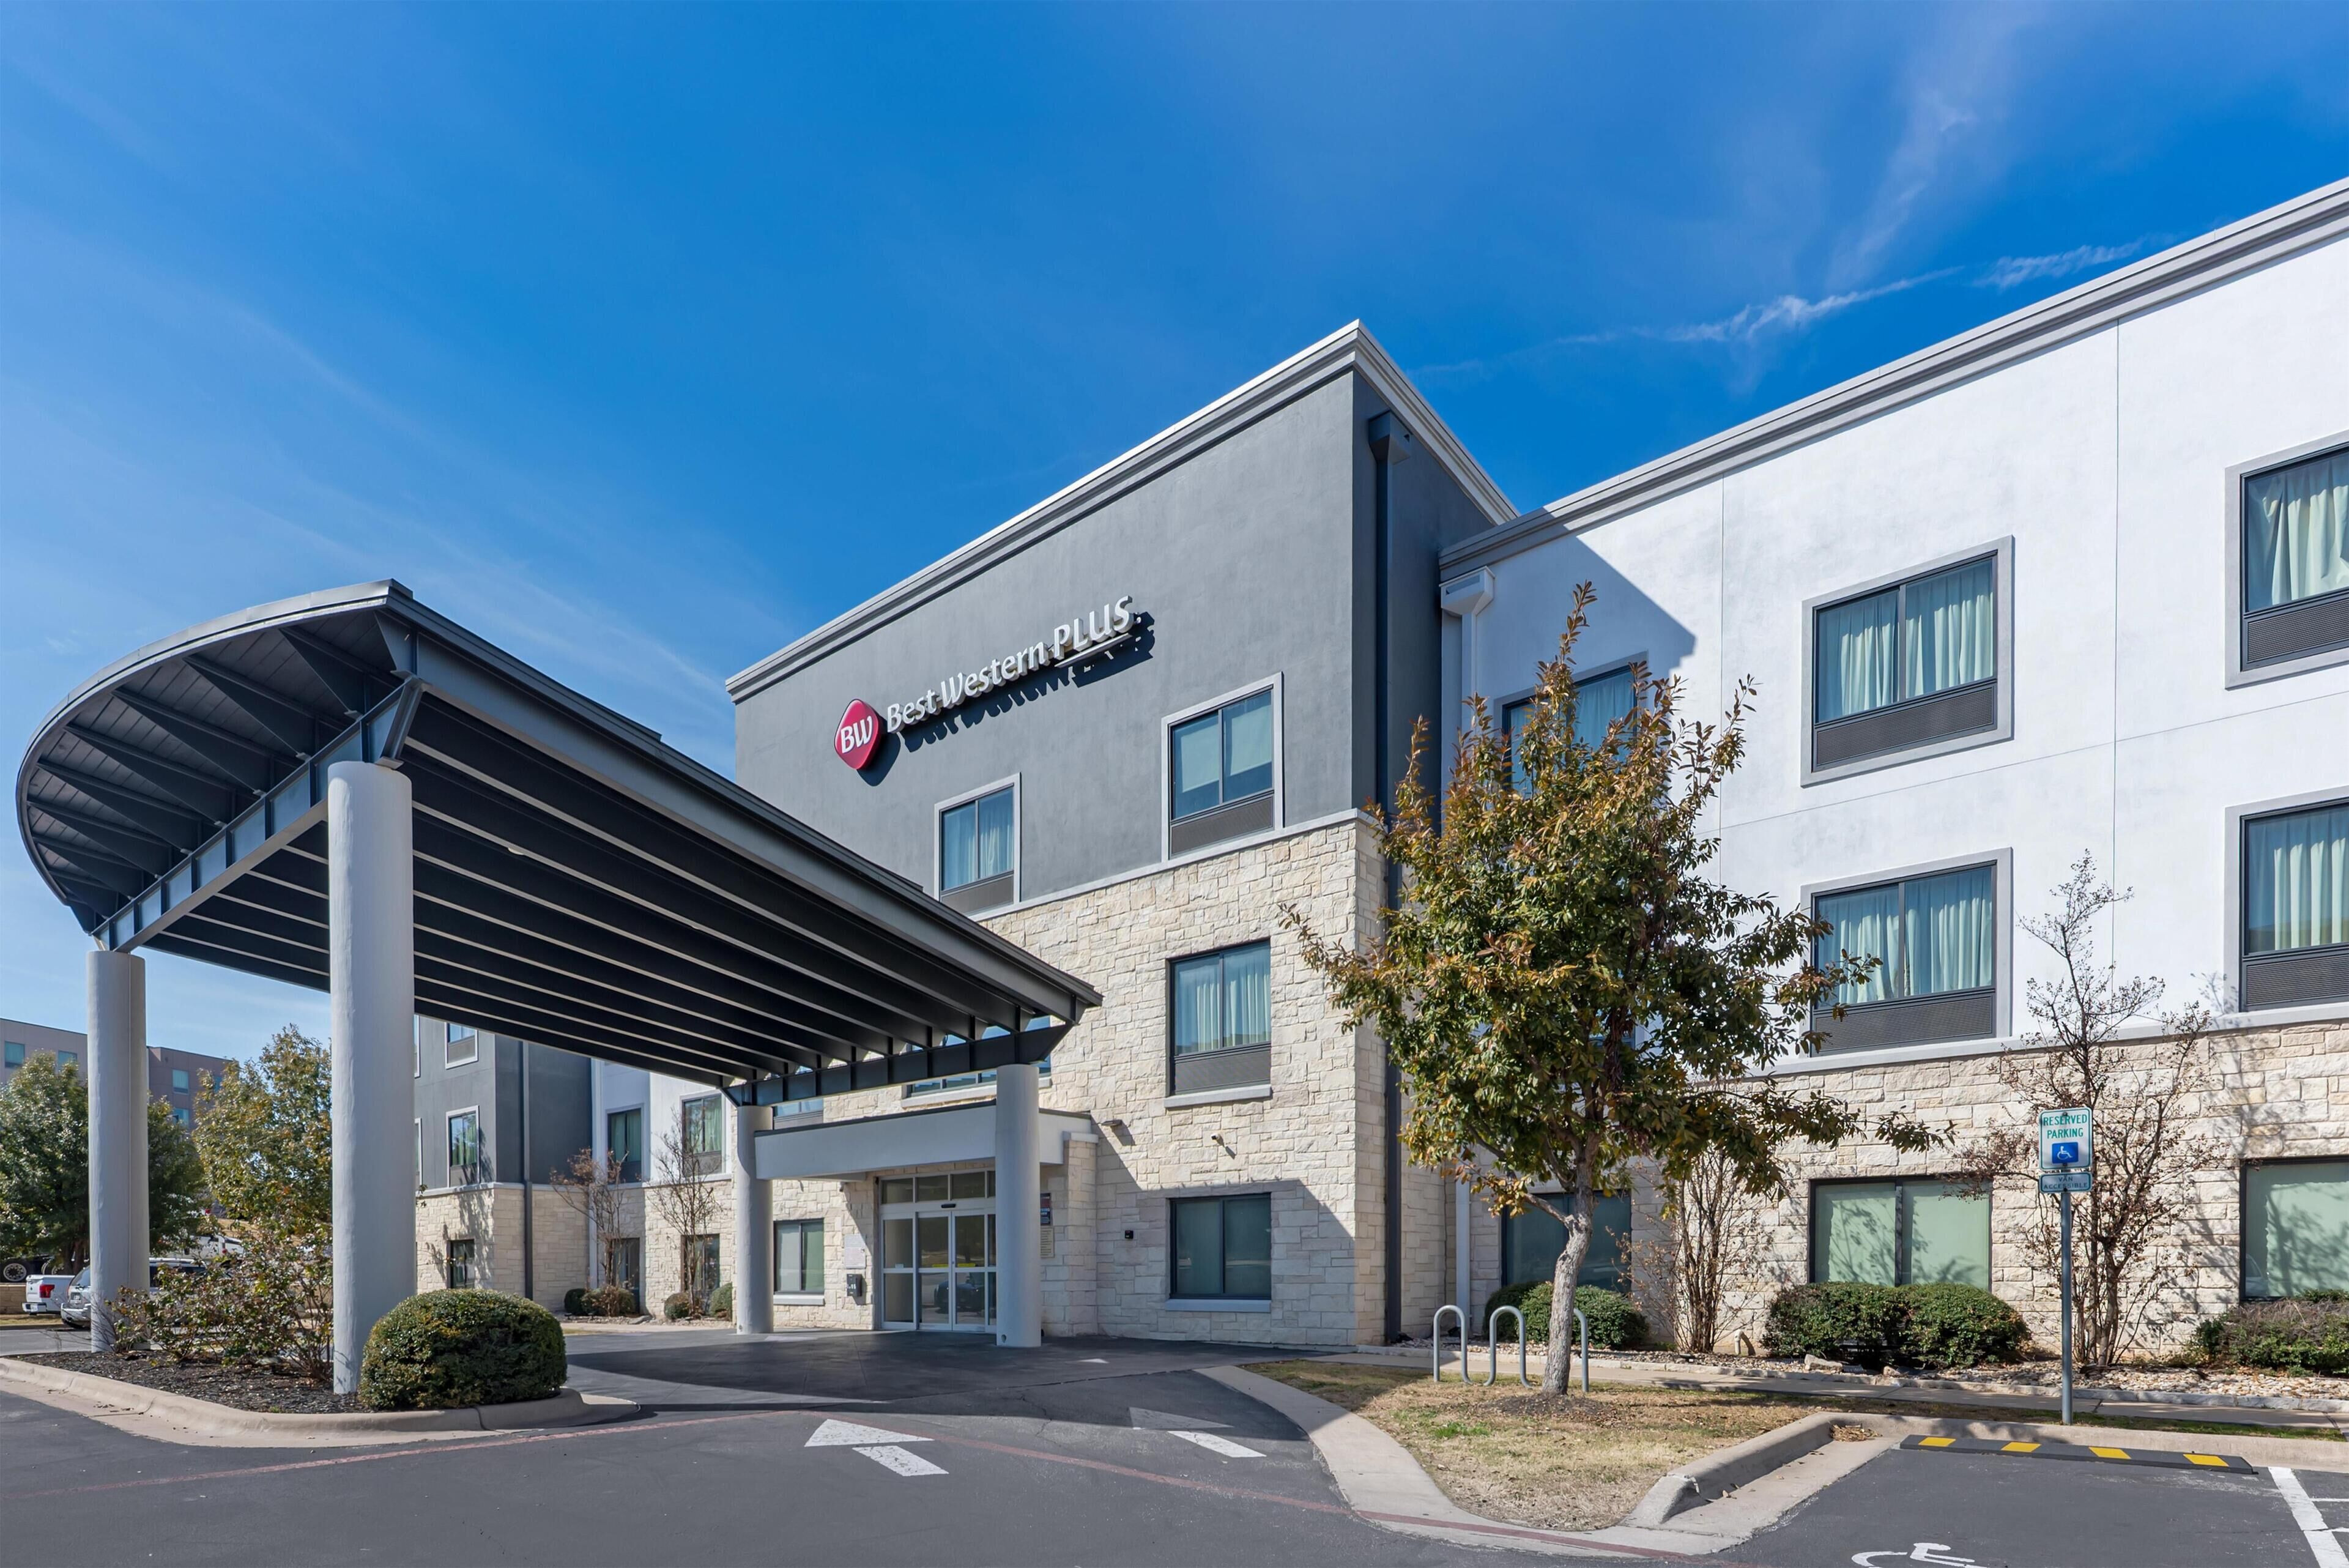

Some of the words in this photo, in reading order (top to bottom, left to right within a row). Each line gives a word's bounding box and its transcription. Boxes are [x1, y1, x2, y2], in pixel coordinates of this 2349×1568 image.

[887, 689, 938, 734] Best
[940, 641, 1048, 708] Western
[1053, 595, 1134, 660] PLUS
[840, 715, 873, 754] BW
[2043, 1114, 2087, 1126] RESERVED
[2047, 1128, 2084, 1139] PARKING
